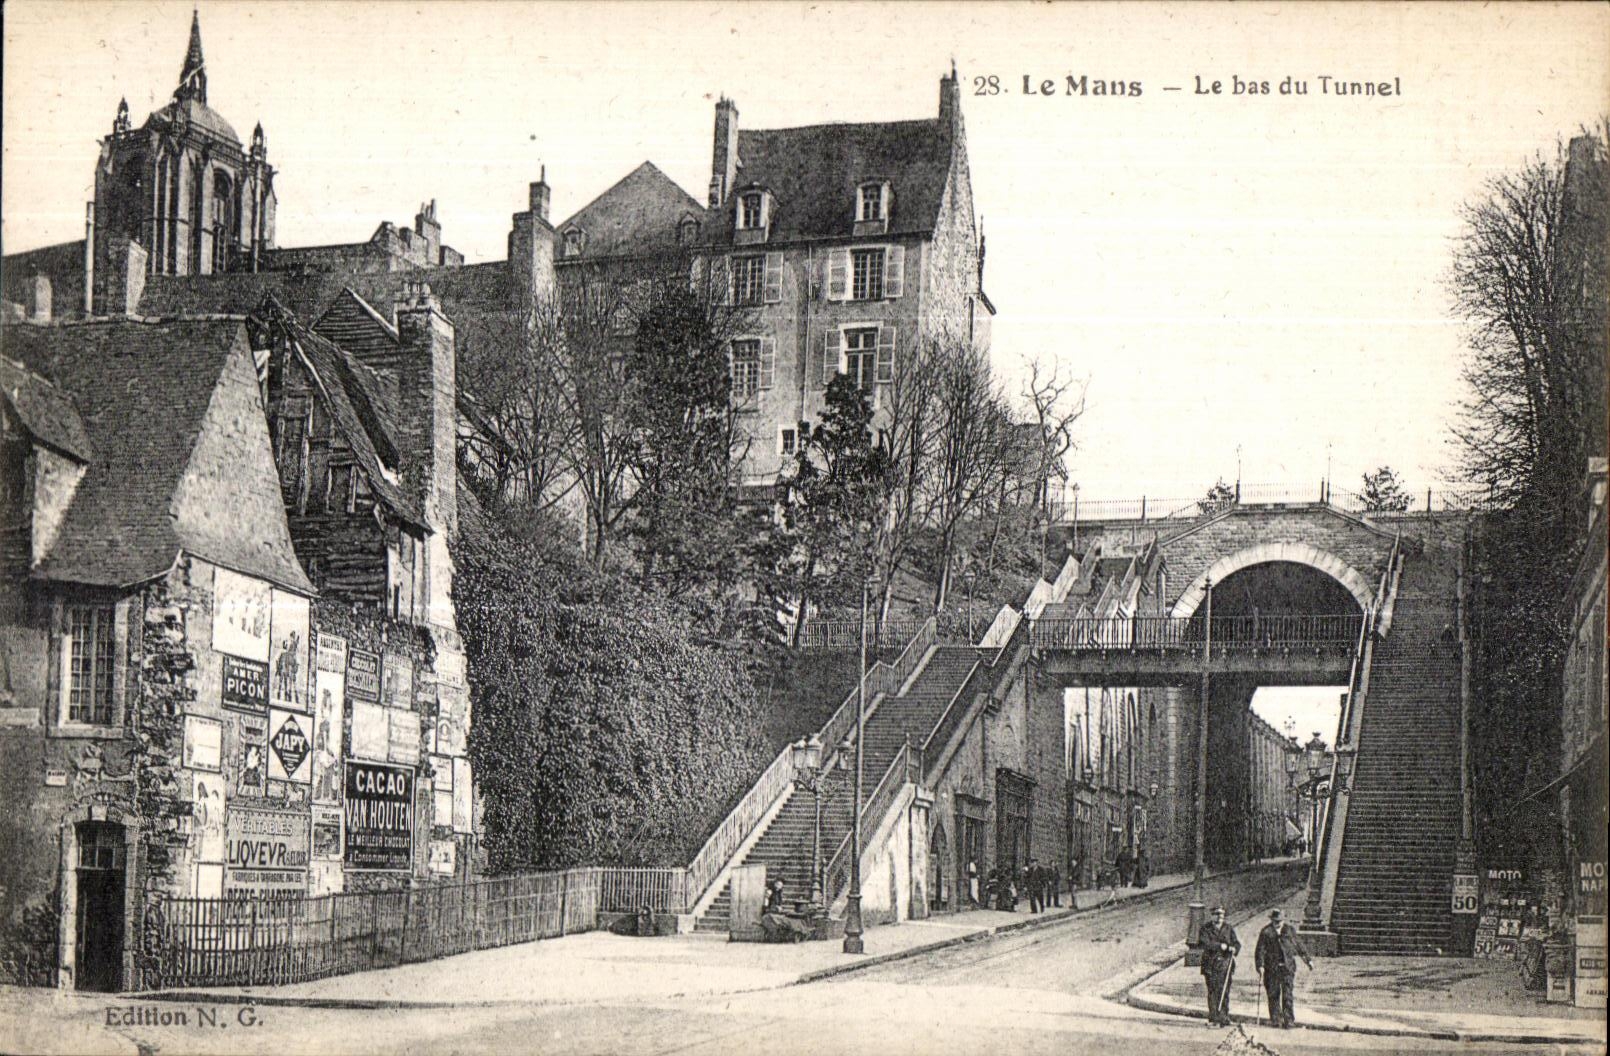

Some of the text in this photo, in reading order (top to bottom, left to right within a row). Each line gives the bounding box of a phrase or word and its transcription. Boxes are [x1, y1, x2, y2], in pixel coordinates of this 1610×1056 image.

[233, 667, 260, 682] AMER
[227, 677, 265, 700] PICON
[275, 732, 306, 753] JAPY
[356, 769, 406, 796] CACAO
[345, 798, 411, 832] VAN HOUTEN
[1580, 862, 1607, 878] MO
[1453, 896, 1477, 911] 50
